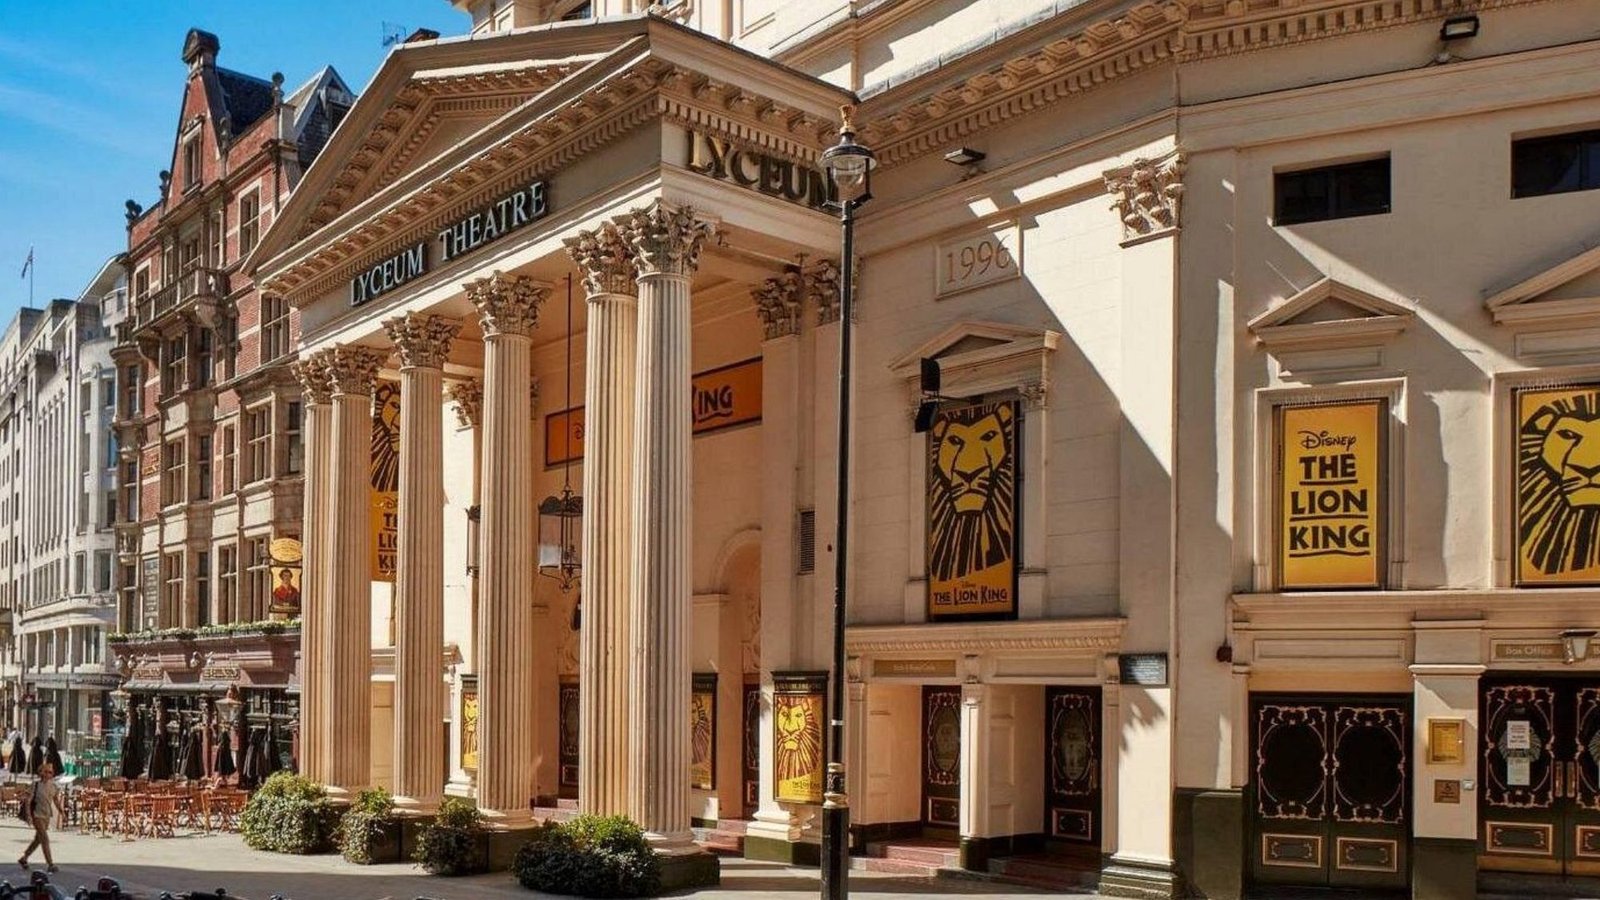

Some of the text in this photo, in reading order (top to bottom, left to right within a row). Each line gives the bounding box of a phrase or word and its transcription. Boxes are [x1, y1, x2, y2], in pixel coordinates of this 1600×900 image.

[687, 130, 838, 207] LYCEUM
[350, 181, 545, 306] LYCEUM THEATRE
[946, 234, 1010, 284] 1996
[1299, 453, 1357, 480] THE
[1291, 489, 1368, 515] LION
[1289, 524, 1370, 551] KING
[934, 585, 1008, 605] THE LION KING
